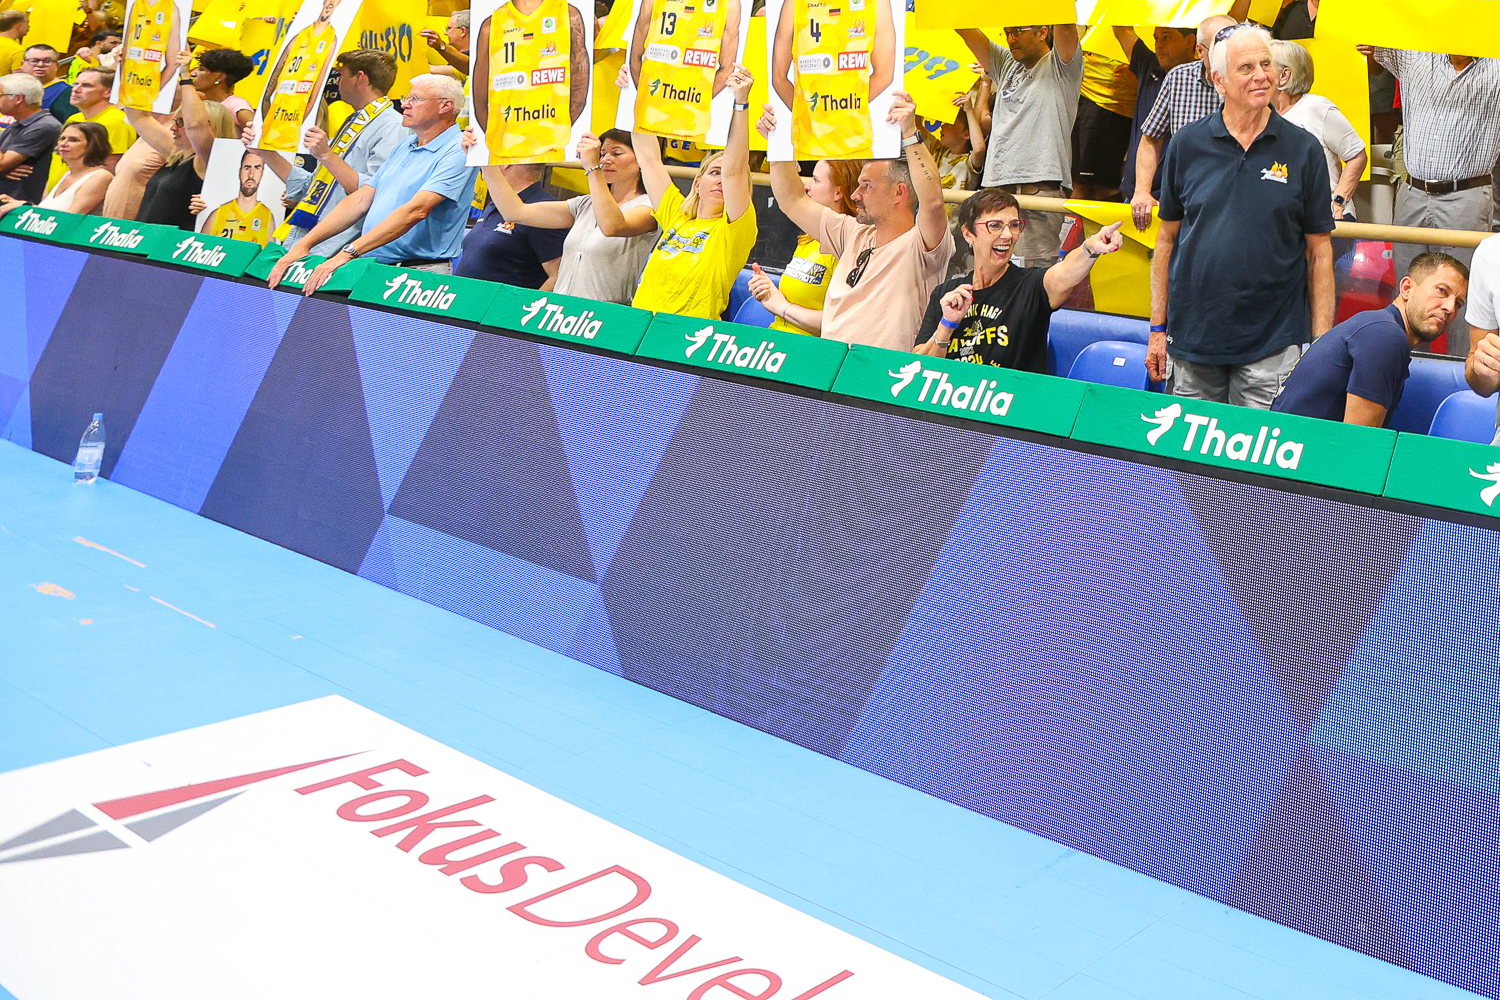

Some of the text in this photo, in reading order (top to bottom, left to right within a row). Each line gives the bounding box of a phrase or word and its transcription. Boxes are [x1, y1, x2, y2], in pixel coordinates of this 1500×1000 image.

[660, 11, 677, 35] 13
[810, 18, 822, 43] 4
[288, 56, 302, 73] 30
[504, 42, 515, 63] 11
[684, 50, 717, 67] REWE
[532, 68, 565, 83] REWE
[28, 212, 56, 237] Thalia
[102, 225, 142, 249] Thalia
[188, 241, 227, 267] Thalia
[402, 279, 457, 311] Thalia
[542, 305, 603, 341] Thalia
[708, 332, 787, 375] Thalia
[920, 369, 1014, 417] Thalia
[1182, 414, 1304, 470] Thalia
